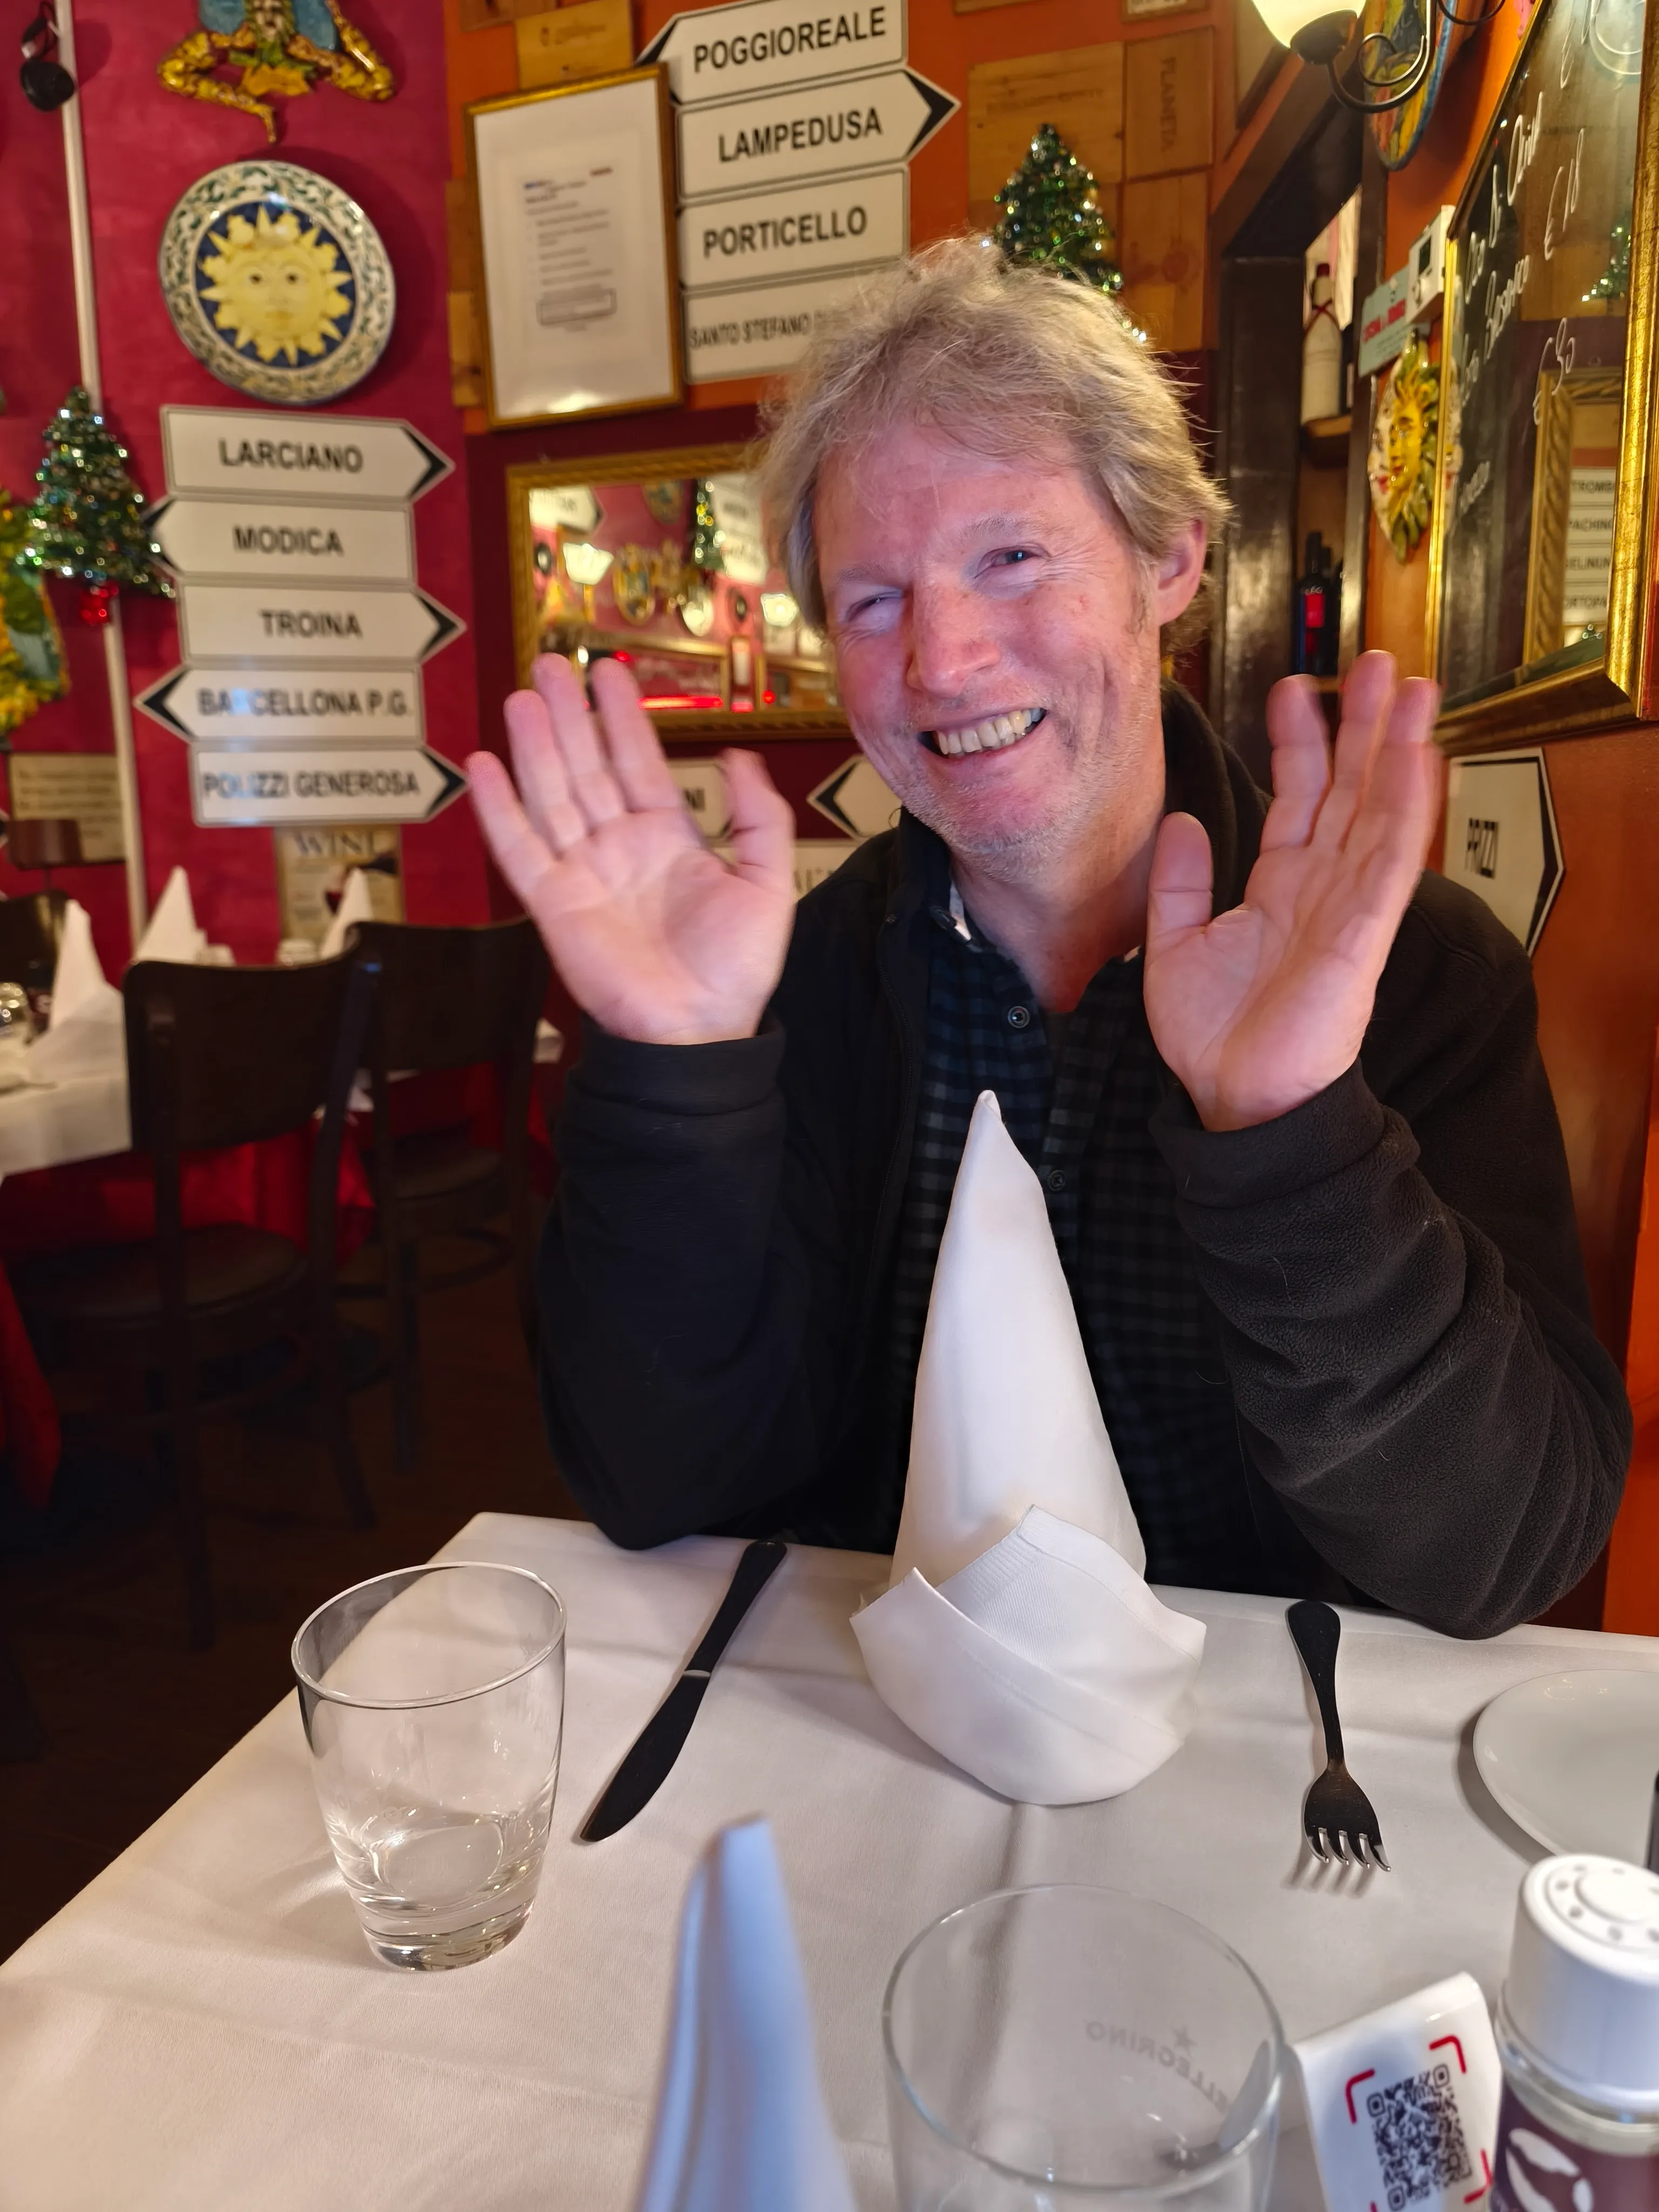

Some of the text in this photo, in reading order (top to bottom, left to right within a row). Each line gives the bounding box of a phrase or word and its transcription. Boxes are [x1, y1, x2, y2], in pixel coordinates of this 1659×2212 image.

[693, 6, 886, 73] POGGIOREALE
[718, 107, 883, 163] LAMPEDUSA
[704, 206, 867, 258] PORTICELLO
[689, 322, 740, 349] SANTO
[741, 312, 810, 344] STEFANO
[218, 437, 363, 474] LARCIANO
[1571, 480, 1615, 494] TROMB
[233, 525, 344, 557] MODICA
[259, 609, 362, 640] TROINA
[197, 686, 363, 717] BACELLONA
[294, 769, 421, 798] GENEROSA
